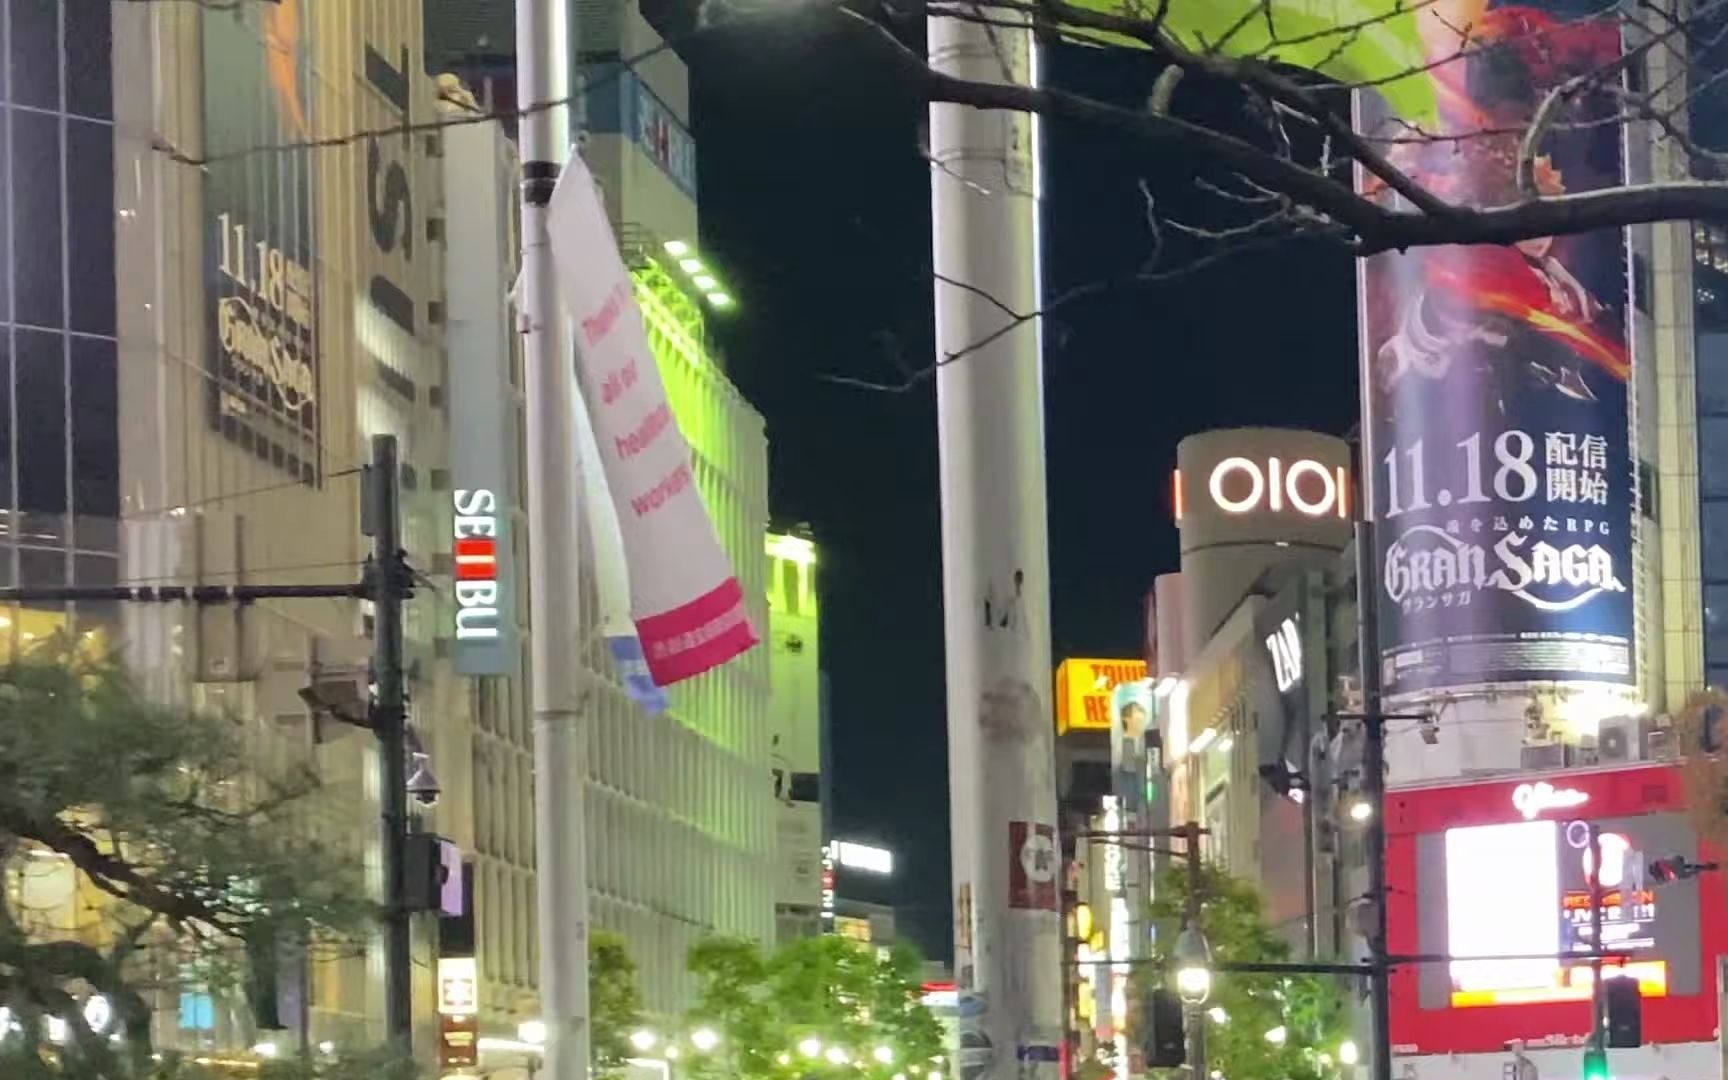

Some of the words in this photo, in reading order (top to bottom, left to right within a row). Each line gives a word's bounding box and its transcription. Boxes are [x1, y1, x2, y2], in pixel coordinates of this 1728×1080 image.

[1384, 430, 1537, 519] 11.18
[1545, 432, 1608, 469] 配信
[1545, 468, 1608, 506] 開始
[454, 489, 498, 640] SEIBU
